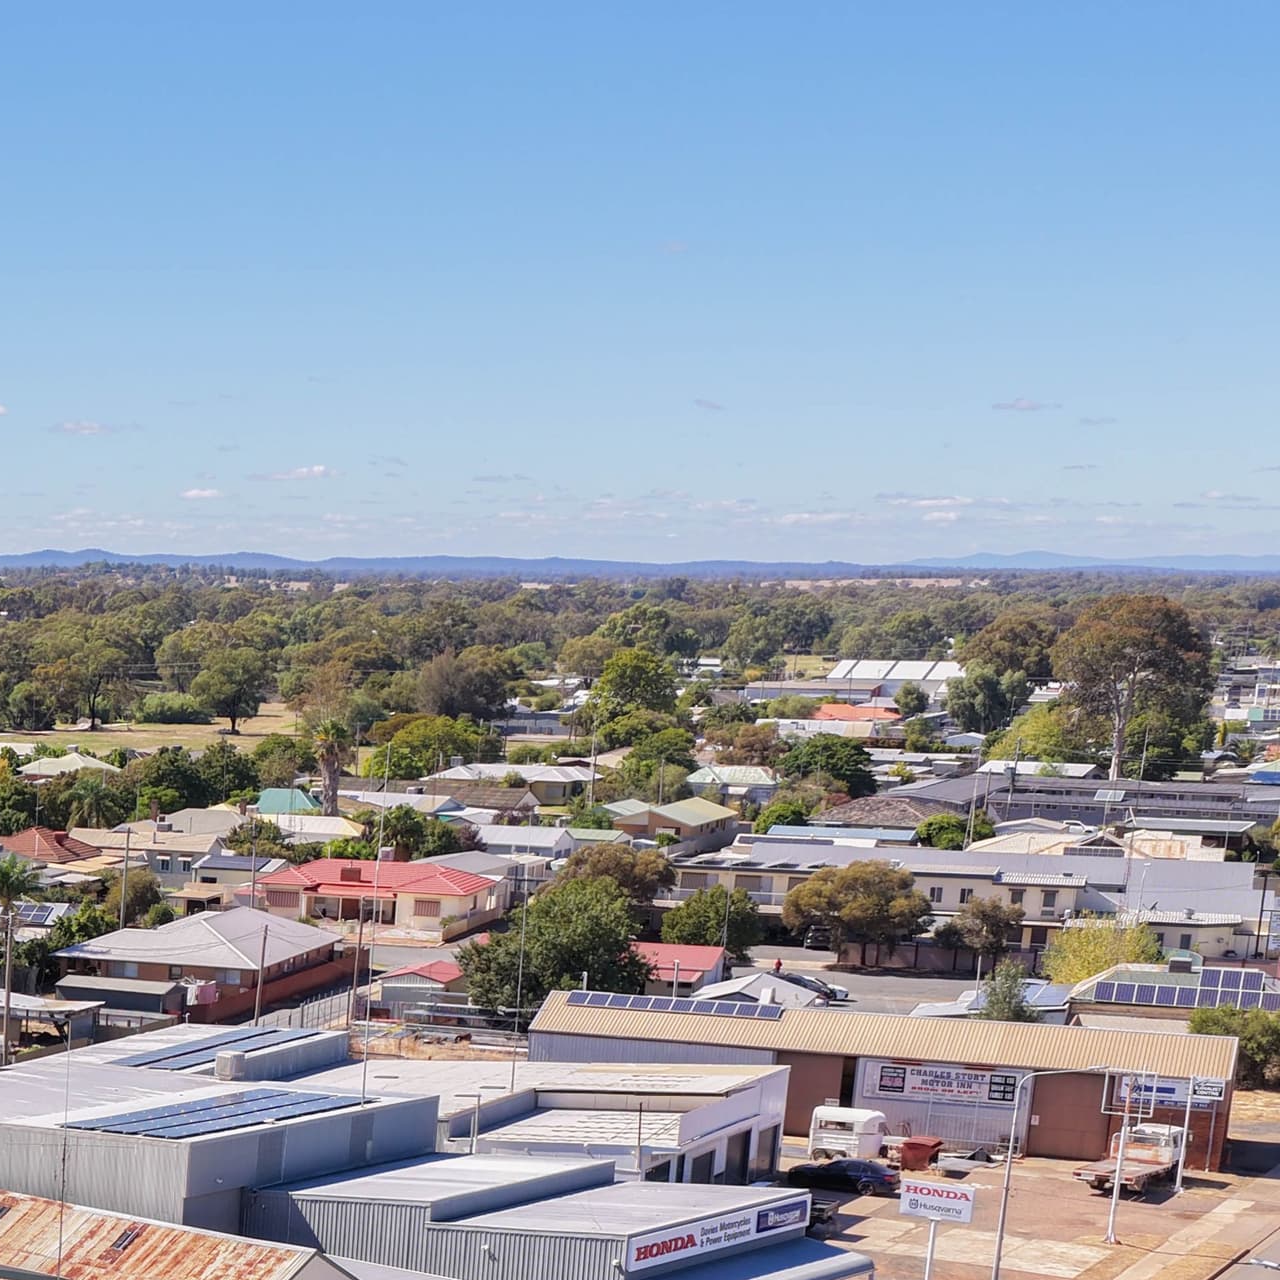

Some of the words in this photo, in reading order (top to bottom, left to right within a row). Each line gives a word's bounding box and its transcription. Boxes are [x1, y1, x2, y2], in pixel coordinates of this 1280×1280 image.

[910, 1068, 951, 1080] CHARLES
[955, 1073, 987, 1081] STURT
[921, 1078, 953, 1088] MOTOR
[957, 1082, 973, 1090] INN
[905, 1185, 971, 1202] HONDA
[920, 1202, 962, 1215] Husqvarna
[700, 1226, 719, 1237] Davies
[719, 1217, 751, 1231] Motorcycles
[705, 1235, 722, 1246] Power
[723, 1228, 751, 1243] Equipment
[635, 1233, 697, 1261] HONDA
